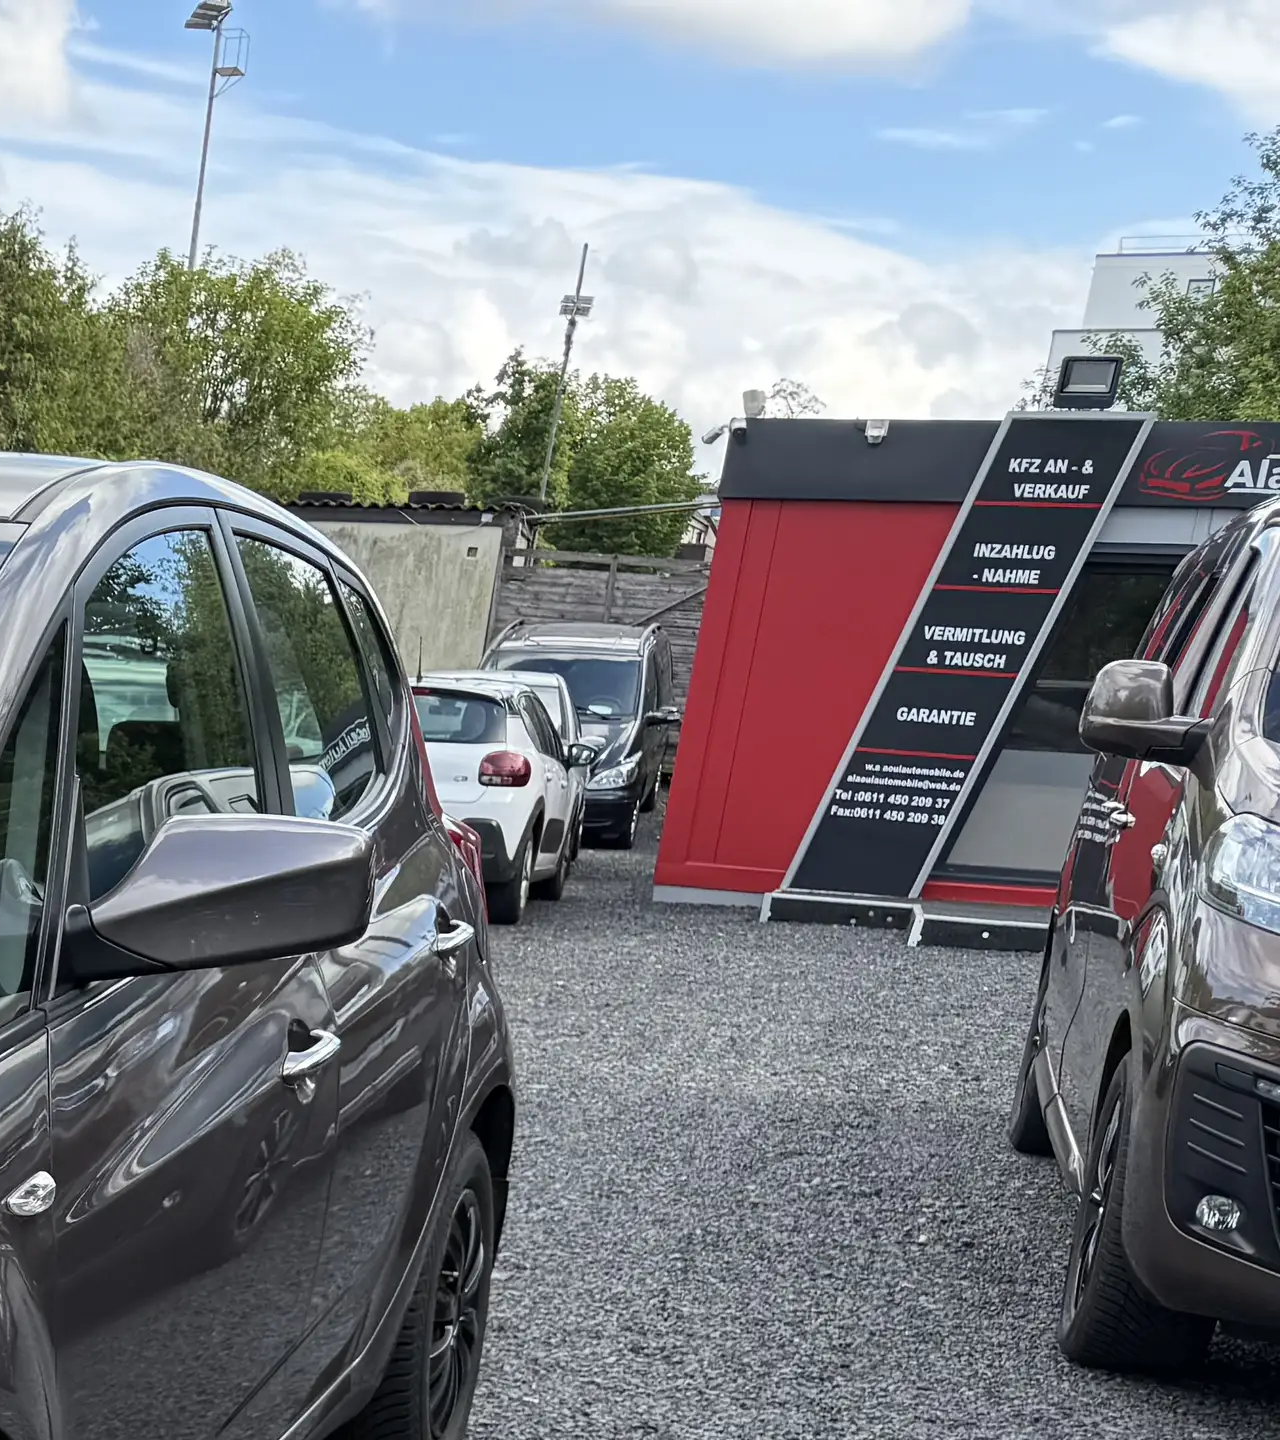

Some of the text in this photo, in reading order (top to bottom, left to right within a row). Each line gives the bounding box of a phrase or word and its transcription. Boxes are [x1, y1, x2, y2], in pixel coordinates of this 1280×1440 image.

[1008, 458, 1040, 474] KFZ
[1044, 458, 1069, 474] AN
[1081, 459, 1094, 475] &
[1013, 483, 1091, 500] VERKAUF
[973, 542, 1057, 561] INZAHLUG
[981, 567, 1041, 585] NAHME
[923, 625, 1027, 646] VERMITLUNG
[926, 649, 1007, 669] & TAUSCH
[896, 706, 977, 727] GARANTIE
[835, 788, 852, 801] Tel
[887, 794, 909, 806] 450
[910, 795, 933, 808] 209
[935, 798, 951, 810] 37
[883, 809, 906, 822] 450
[906, 811, 929, 824] 209
[930, 814, 946, 826] 38
